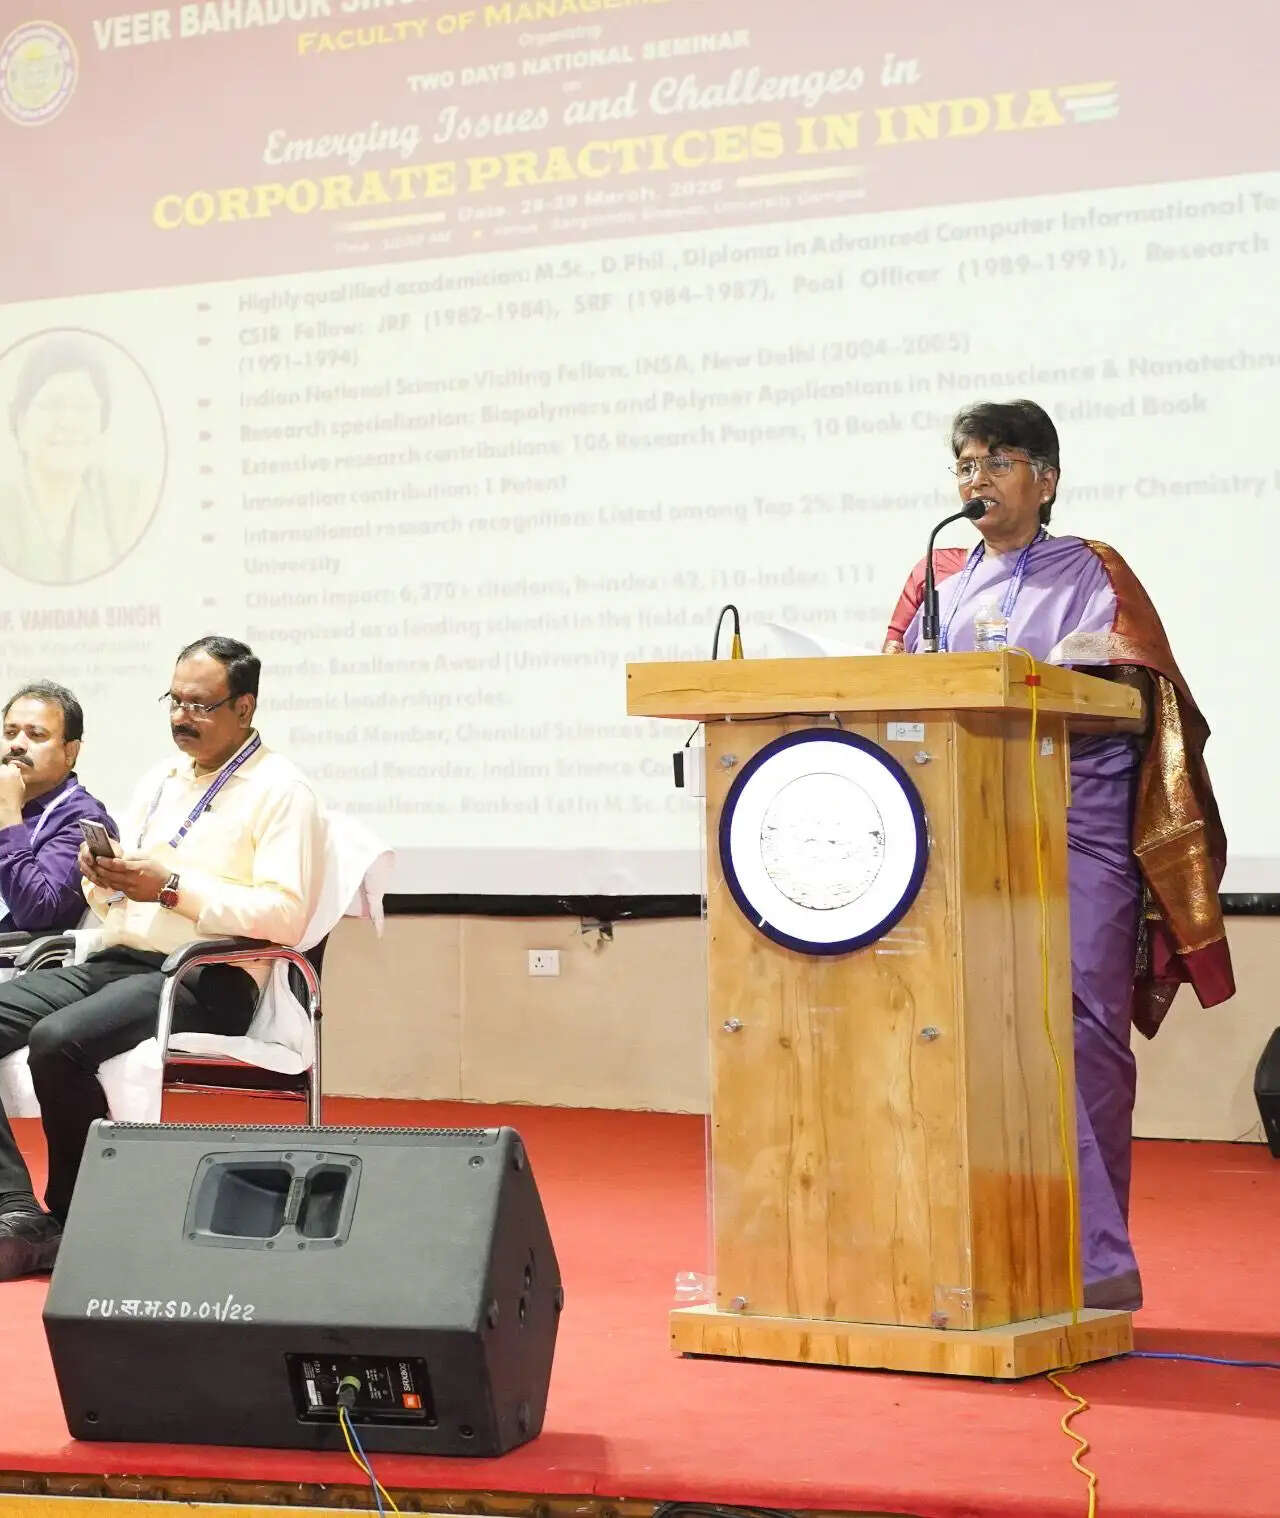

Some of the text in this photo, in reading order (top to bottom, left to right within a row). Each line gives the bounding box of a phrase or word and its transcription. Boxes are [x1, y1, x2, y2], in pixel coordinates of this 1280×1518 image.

[92, 9, 172, 51] VEER
[296, 18, 430, 56] FACULTY
[436, 11, 476, 34] OF
[407, 29, 751, 93] TWO DAYS NATIONAL SEMINAR
[263, 52, 922, 165] Emerging Issues and Challenges in
[152, 87, 1066, 230] CORPORATE PRACTICES IN INDIA
[239, 292, 300, 314] Highly
[683, 244, 780, 270] Diploma
[785, 241, 807, 258] in
[810, 225, 929, 254] Advanced
[936, 215, 1055, 246] Computer
[1062, 193, 1244, 232] Informational
[239, 325, 280, 346] CSIR
[573, 292, 614, 316] SRF
[860, 264, 942, 288] Officer
[1144, 232, 1270, 263] Research
[239, 387, 301, 410] Indian
[305, 377, 391, 405] National
[396, 371, 469, 396] Science
[473, 364, 552, 389] Visiting
[702, 348, 750, 371] New
[756, 343, 816, 367] Delhi
[239, 419, 326, 443] Research
[615, 390, 657, 415] and
[663, 387, 753, 414] Polymer
[758, 374, 903, 409] Applications
[908, 376, 931, 393] in
[1102, 357, 1120, 379] &
[334, 446, 420, 472] research
[616, 422, 715, 449] Research
[813, 416, 841, 438] 10
[846, 411, 904, 436] Book
[1141, 392, 1208, 417] Book
[243, 520, 371, 544] International
[375, 513, 463, 538] research
[668, 500, 748, 523] among
[1134, 472, 1267, 499] Chemistry
[500, 473, 569, 495] Patent
[243, 553, 342, 575] University
[486, 611, 570, 635] scientist
[598, 608, 633, 629] the
